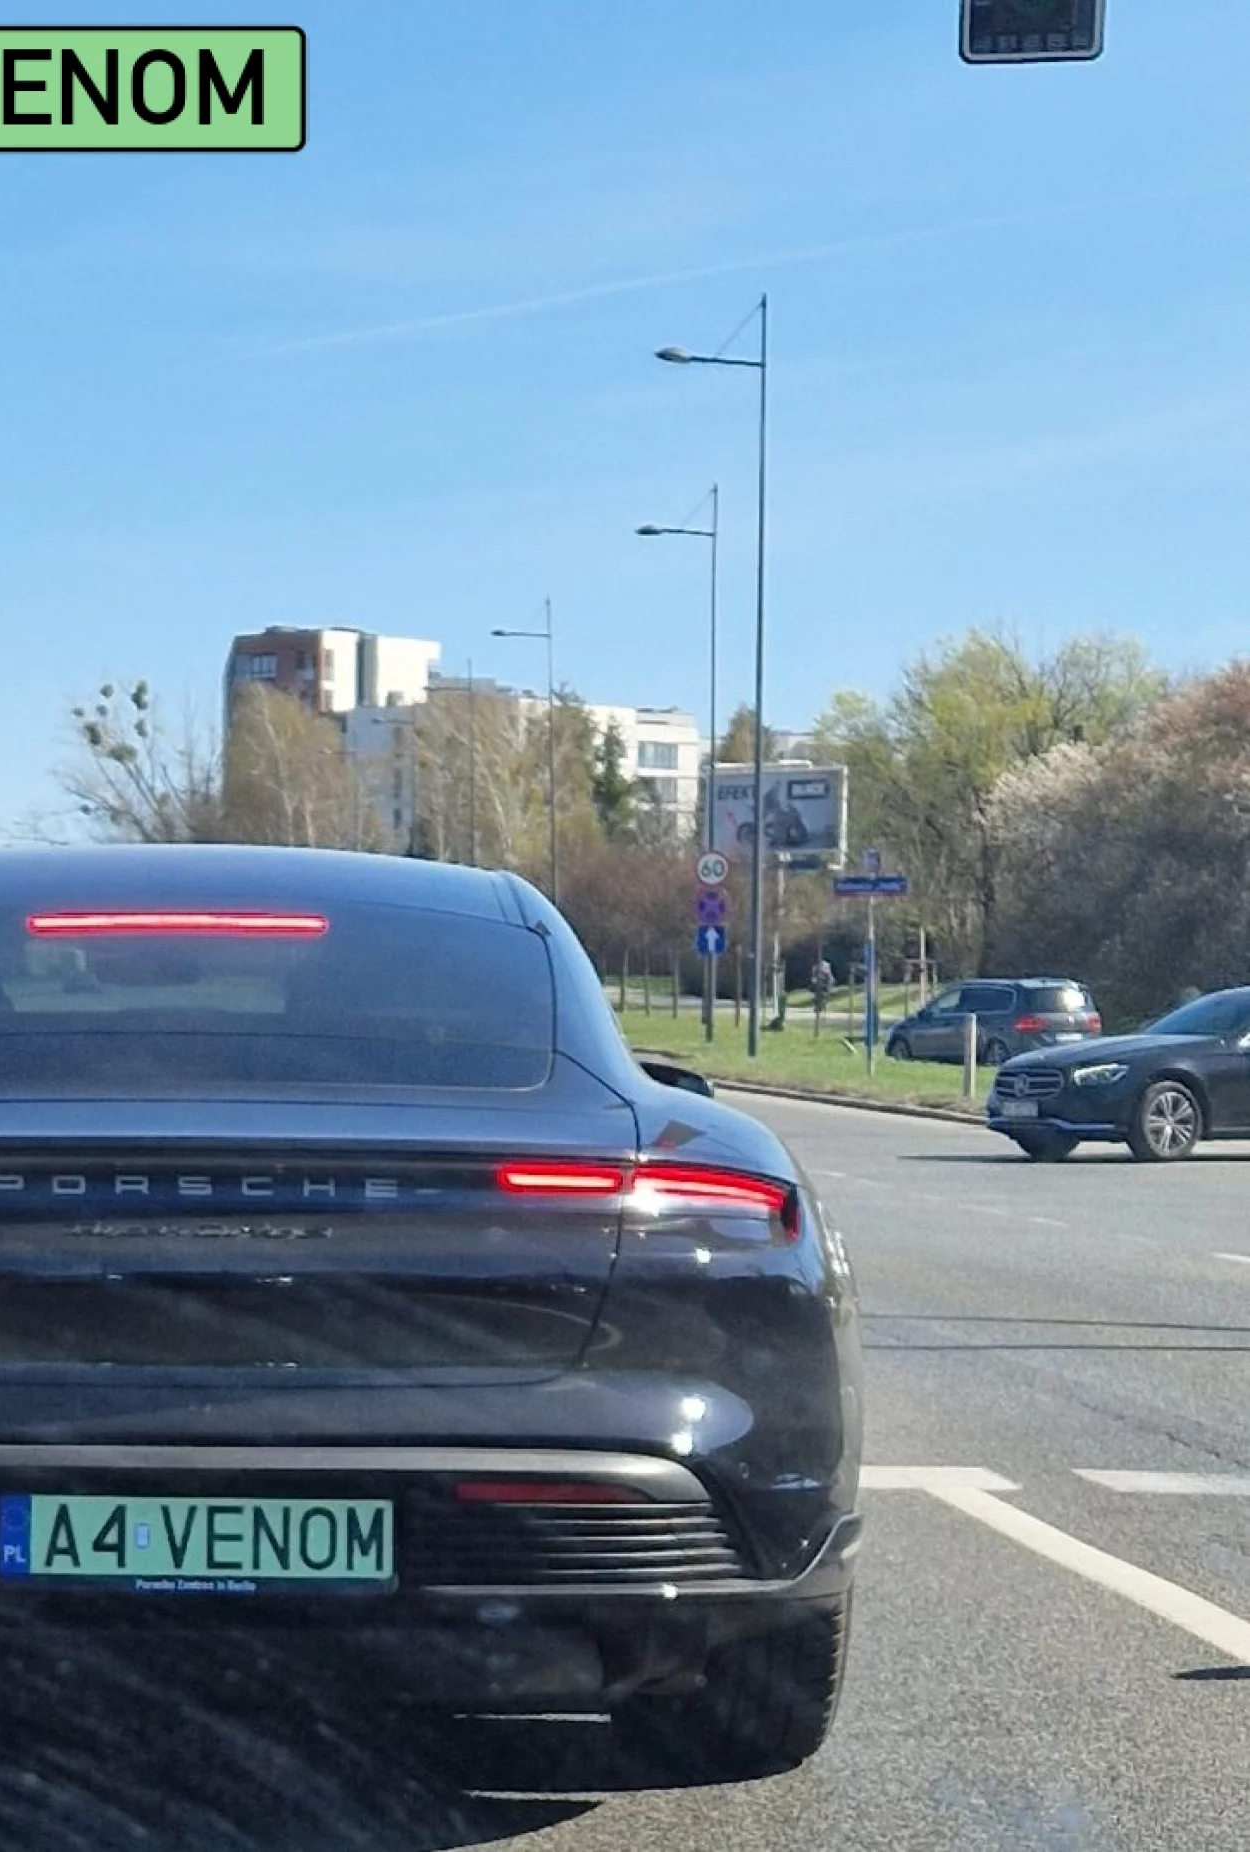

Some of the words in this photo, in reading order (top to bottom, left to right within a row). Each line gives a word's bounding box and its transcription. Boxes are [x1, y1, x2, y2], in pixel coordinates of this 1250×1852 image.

[701, 860, 725, 878] 60
[45, 1503, 127, 1569] A4
[160, 1504, 385, 1572] VENOM
[3, 1544, 26, 1564] PL
